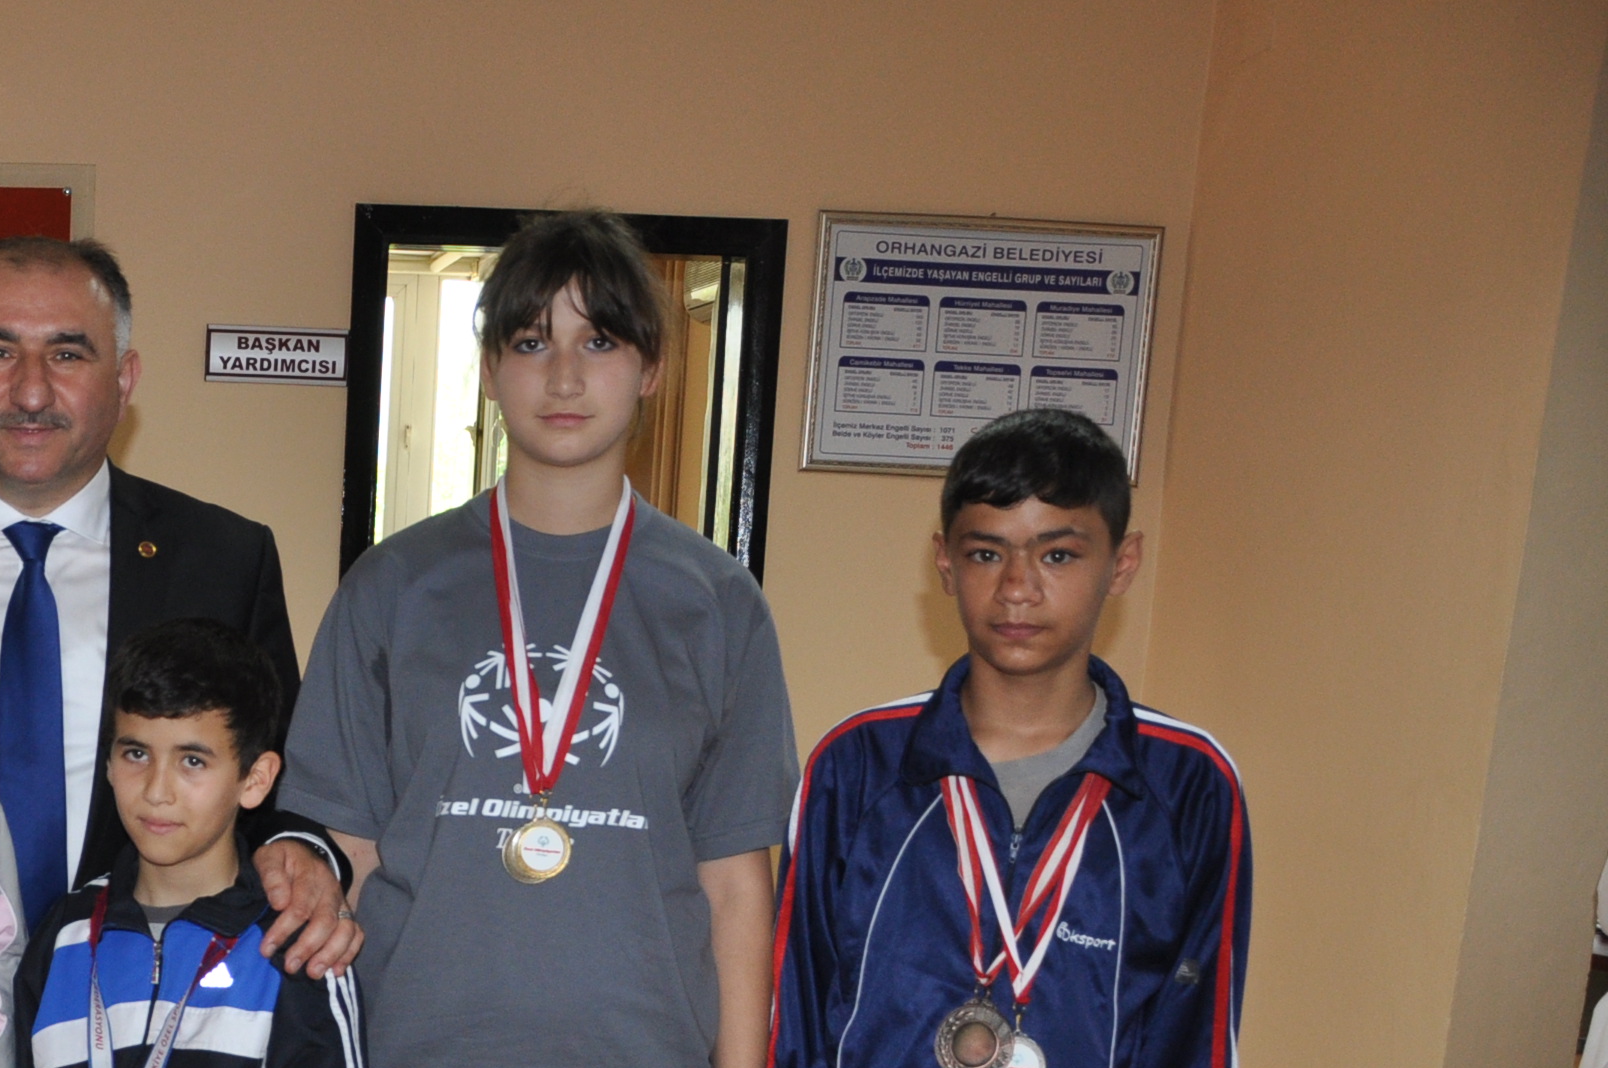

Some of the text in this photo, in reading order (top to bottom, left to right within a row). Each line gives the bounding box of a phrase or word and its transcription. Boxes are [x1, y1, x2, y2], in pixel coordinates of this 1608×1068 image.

[876, 240, 1104, 264] ORHANGAZİ BELEDİYESİ
[873, 263, 1103, 288] İLÇEMİZDE YAŞAYAN ENGELLİ GRUP VE SAYILARI
[237, 336, 321, 354] BAŞKAN
[219, 356, 337, 374] YARDIMCISI
[939, 426, 956, 434] 1071
[481, 798, 649, 830] Olimpiyatla
